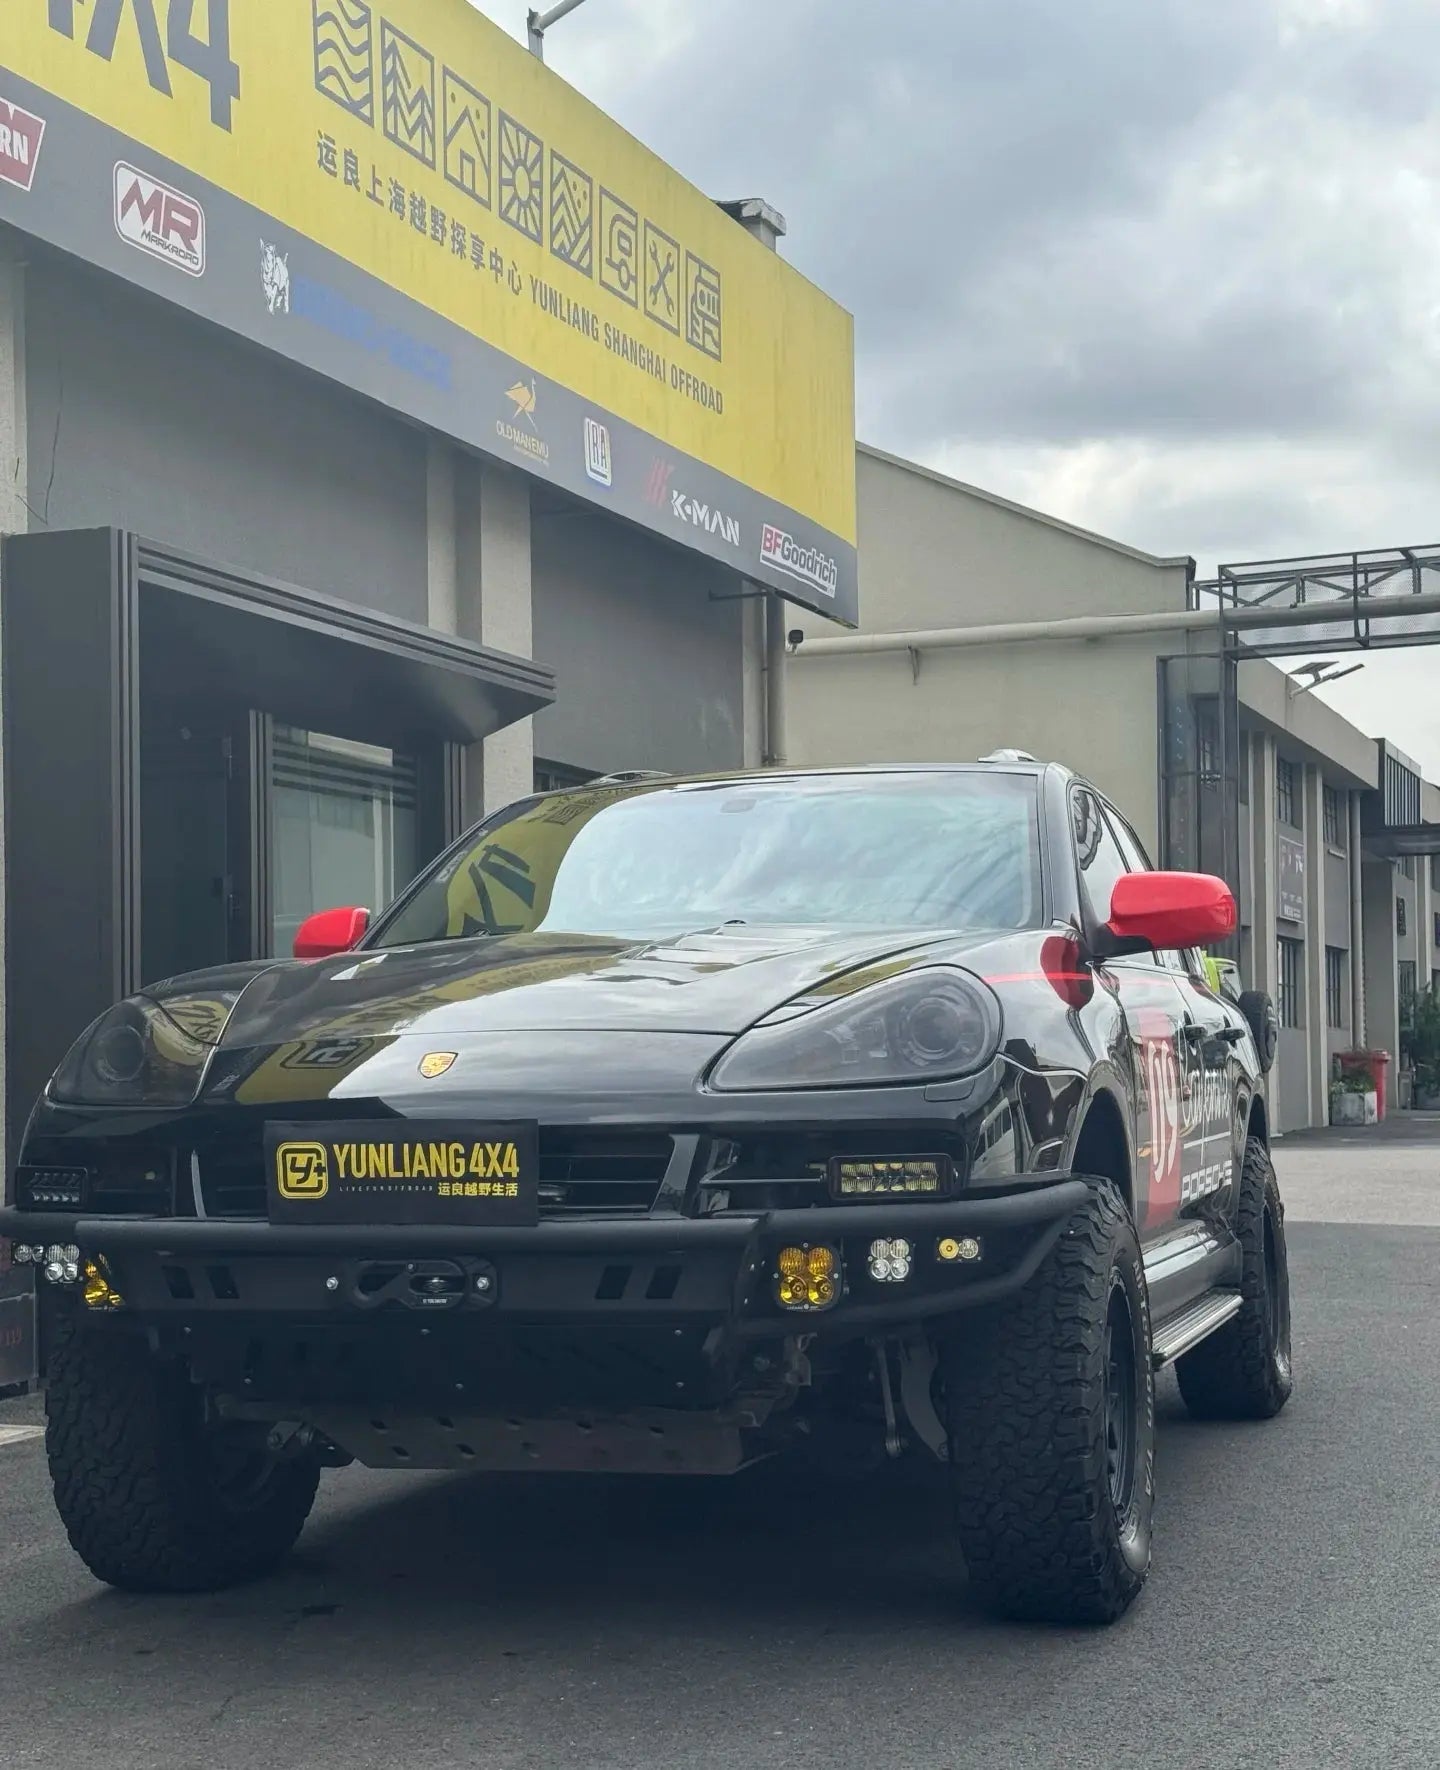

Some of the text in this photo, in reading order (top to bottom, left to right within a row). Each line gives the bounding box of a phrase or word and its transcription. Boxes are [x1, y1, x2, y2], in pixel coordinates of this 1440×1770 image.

[120, 177, 199, 255] MR
[317, 129, 523, 296] 运良上海越野探享中心
[529, 273, 600, 343] YUNLIANG
[604, 321, 667, 384] SHANGHAI
[670, 363, 724, 415] OFFROAD
[762, 526, 837, 586] BFGoodrich
[438, 1182, 519, 1197] 运良越野生活
[1181, 1160, 1232, 1204] PORSCHE
